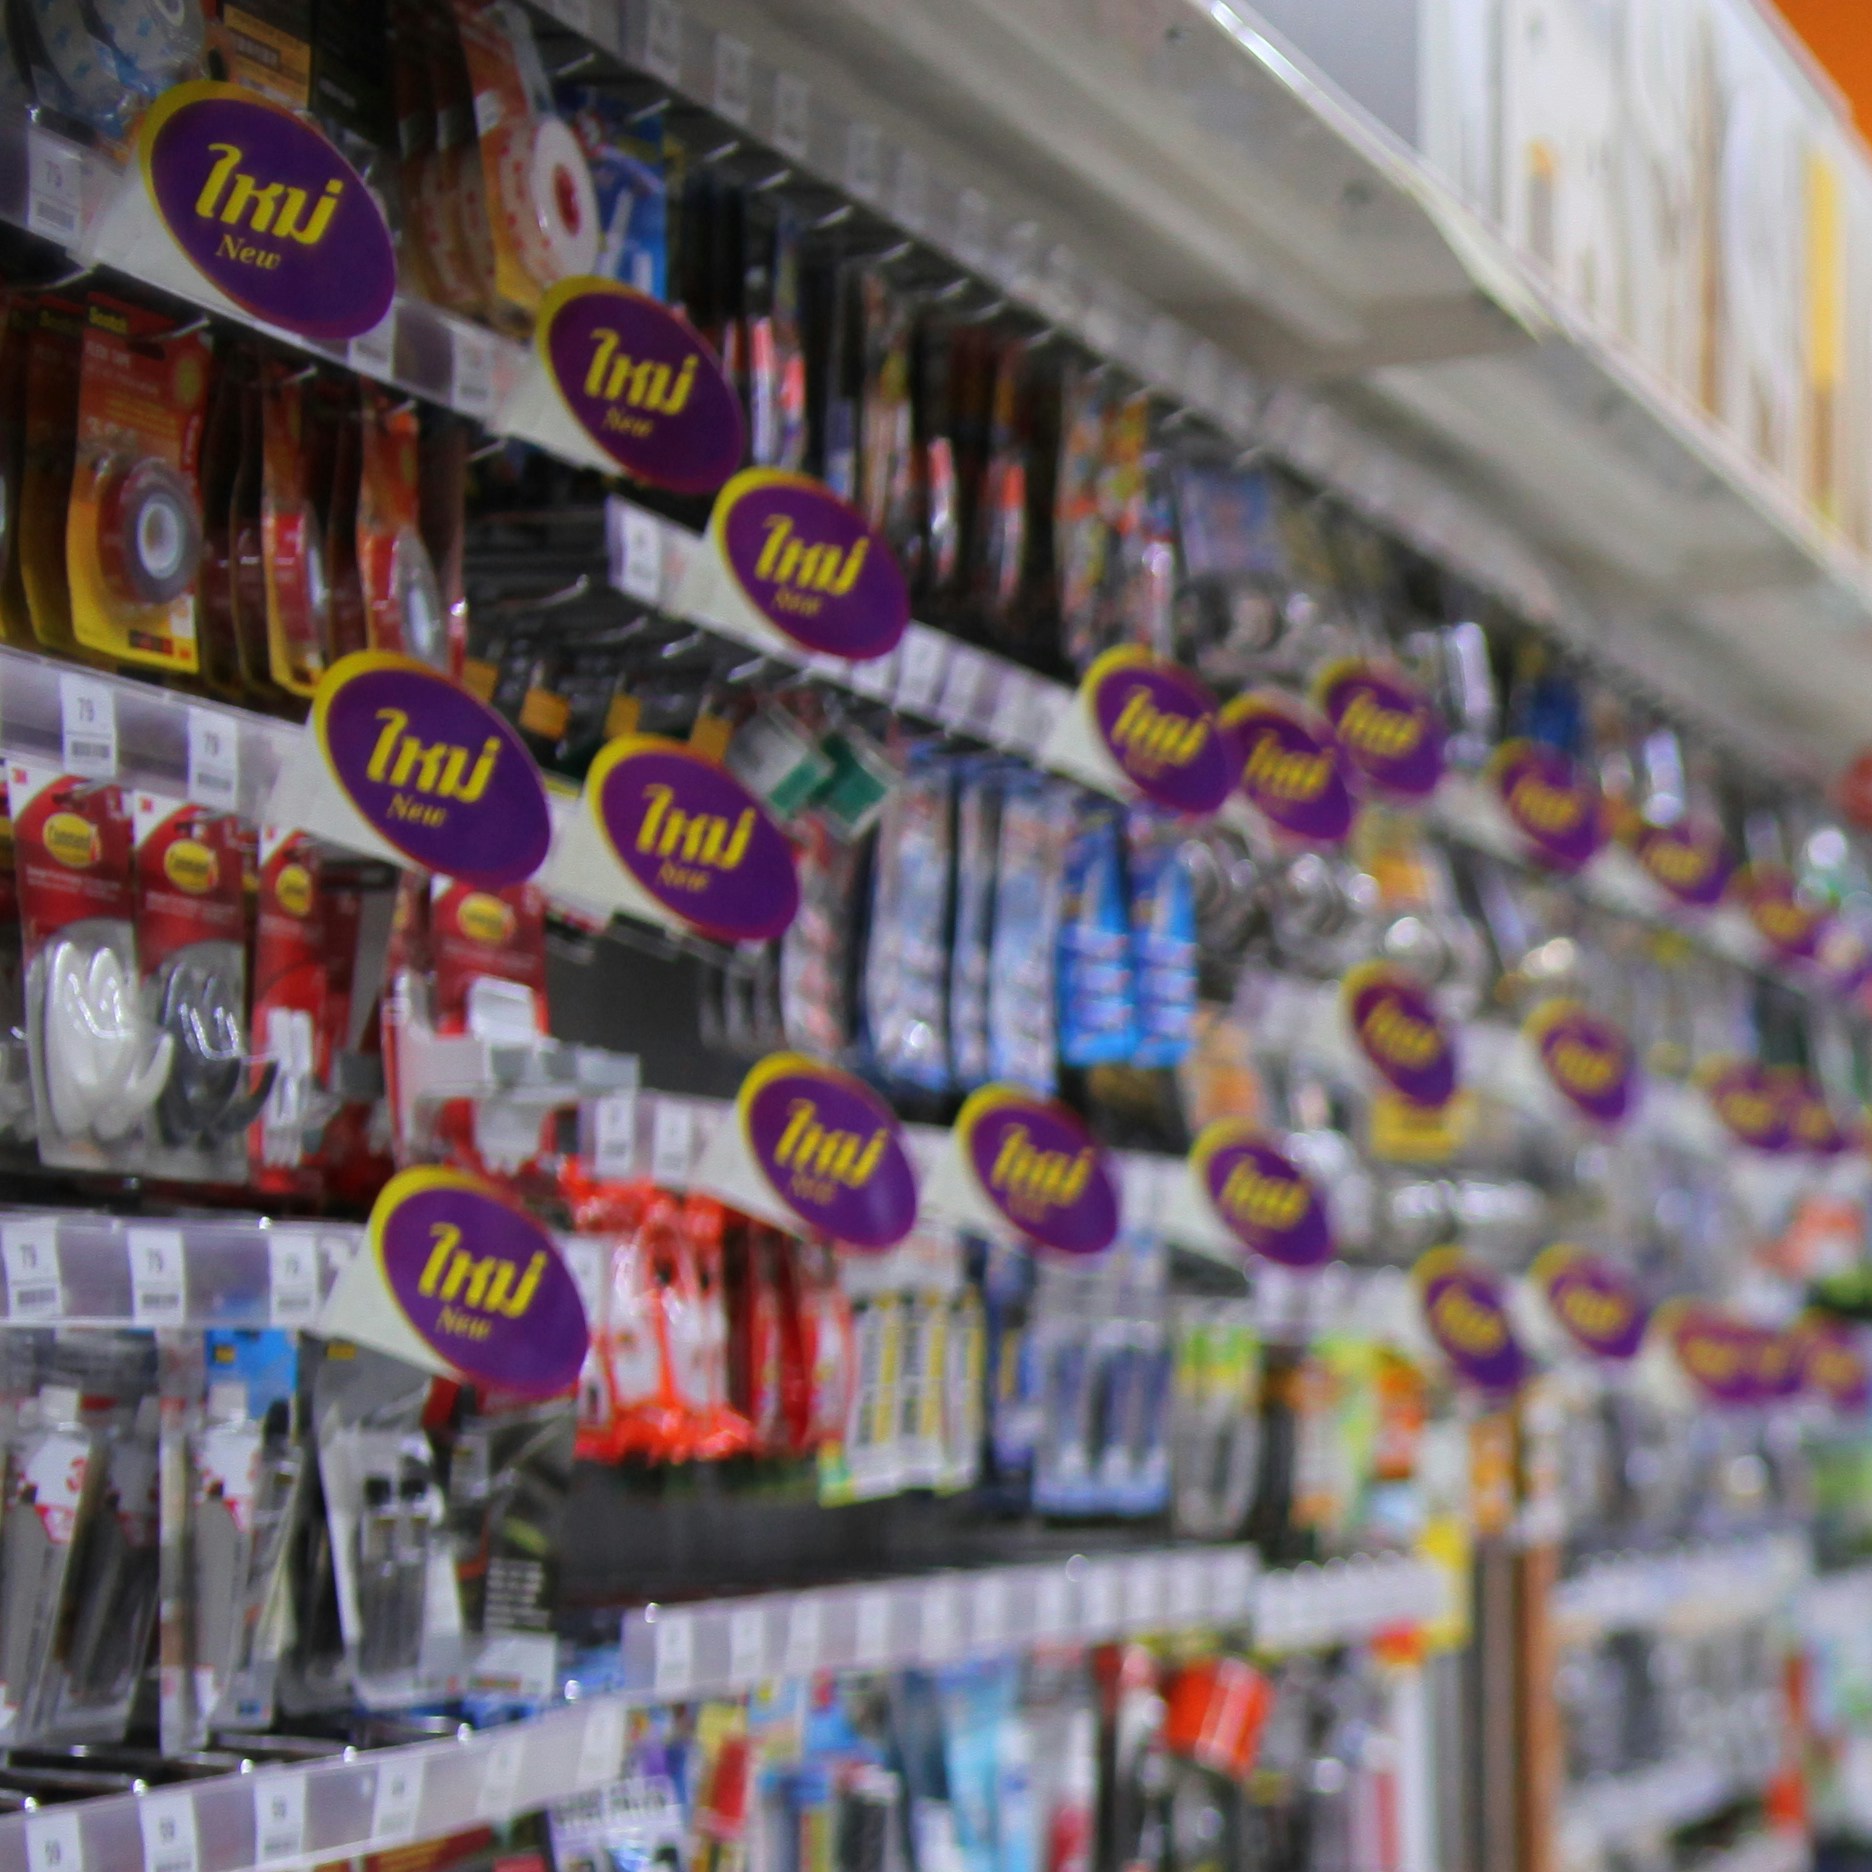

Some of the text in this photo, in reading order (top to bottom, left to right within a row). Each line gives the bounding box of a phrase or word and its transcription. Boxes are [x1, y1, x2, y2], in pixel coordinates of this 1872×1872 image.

[195, 143, 344, 246] ใหม่
[214, 233, 282, 271] New
[582, 328, 699, 415] ใหม่
[752, 515, 871, 596] ใหม่
[367, 709, 501, 803] ใหม่
[388, 793, 448, 829] New
[635, 786, 757, 871] ใหม่
[656, 864, 710, 893] New
[773, 1101, 886, 1187] ใหม่
[418, 1224, 547, 1319] ใหม่
[436, 1308, 492, 1341] New
